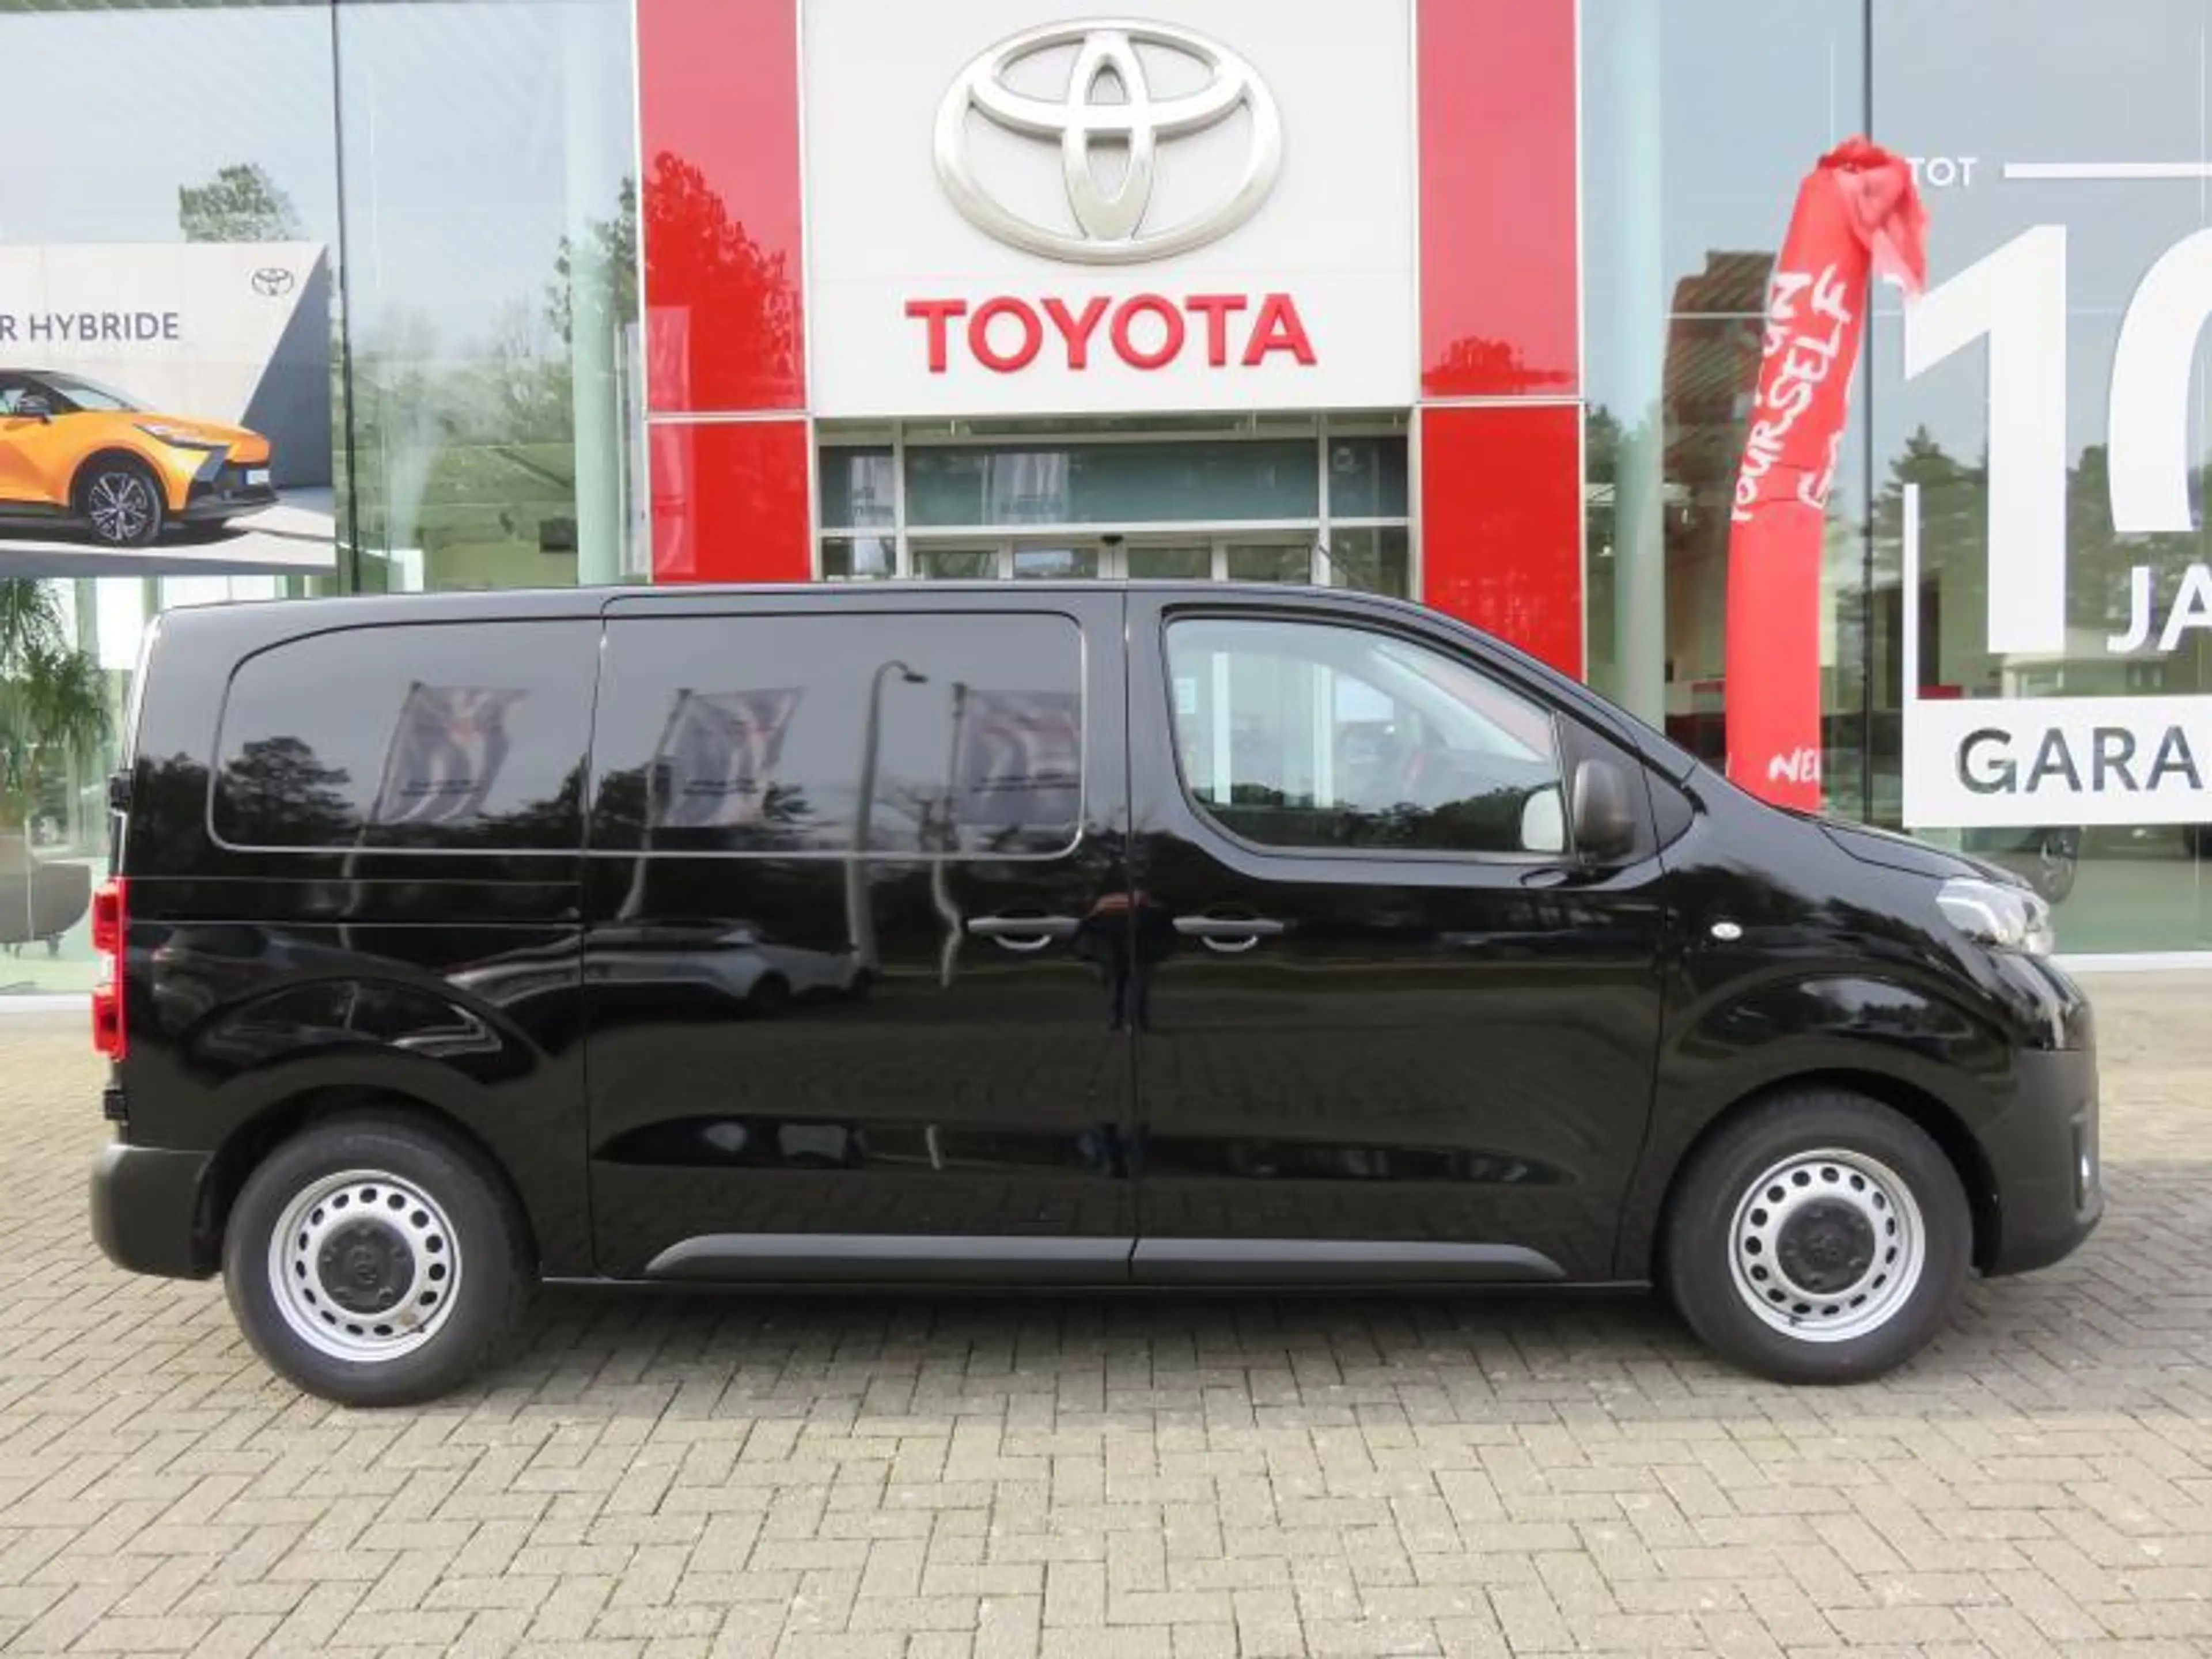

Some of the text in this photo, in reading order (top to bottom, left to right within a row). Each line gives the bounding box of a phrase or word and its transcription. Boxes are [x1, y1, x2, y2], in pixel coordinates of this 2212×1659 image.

[1904, 157, 1978, 185] TOT
[29, 312, 179, 342] HYBRIDE
[906, 293, 1317, 373] TOYOTA
[2107, 564, 2212, 653] JA
[1957, 726, 2203, 794] GARA
